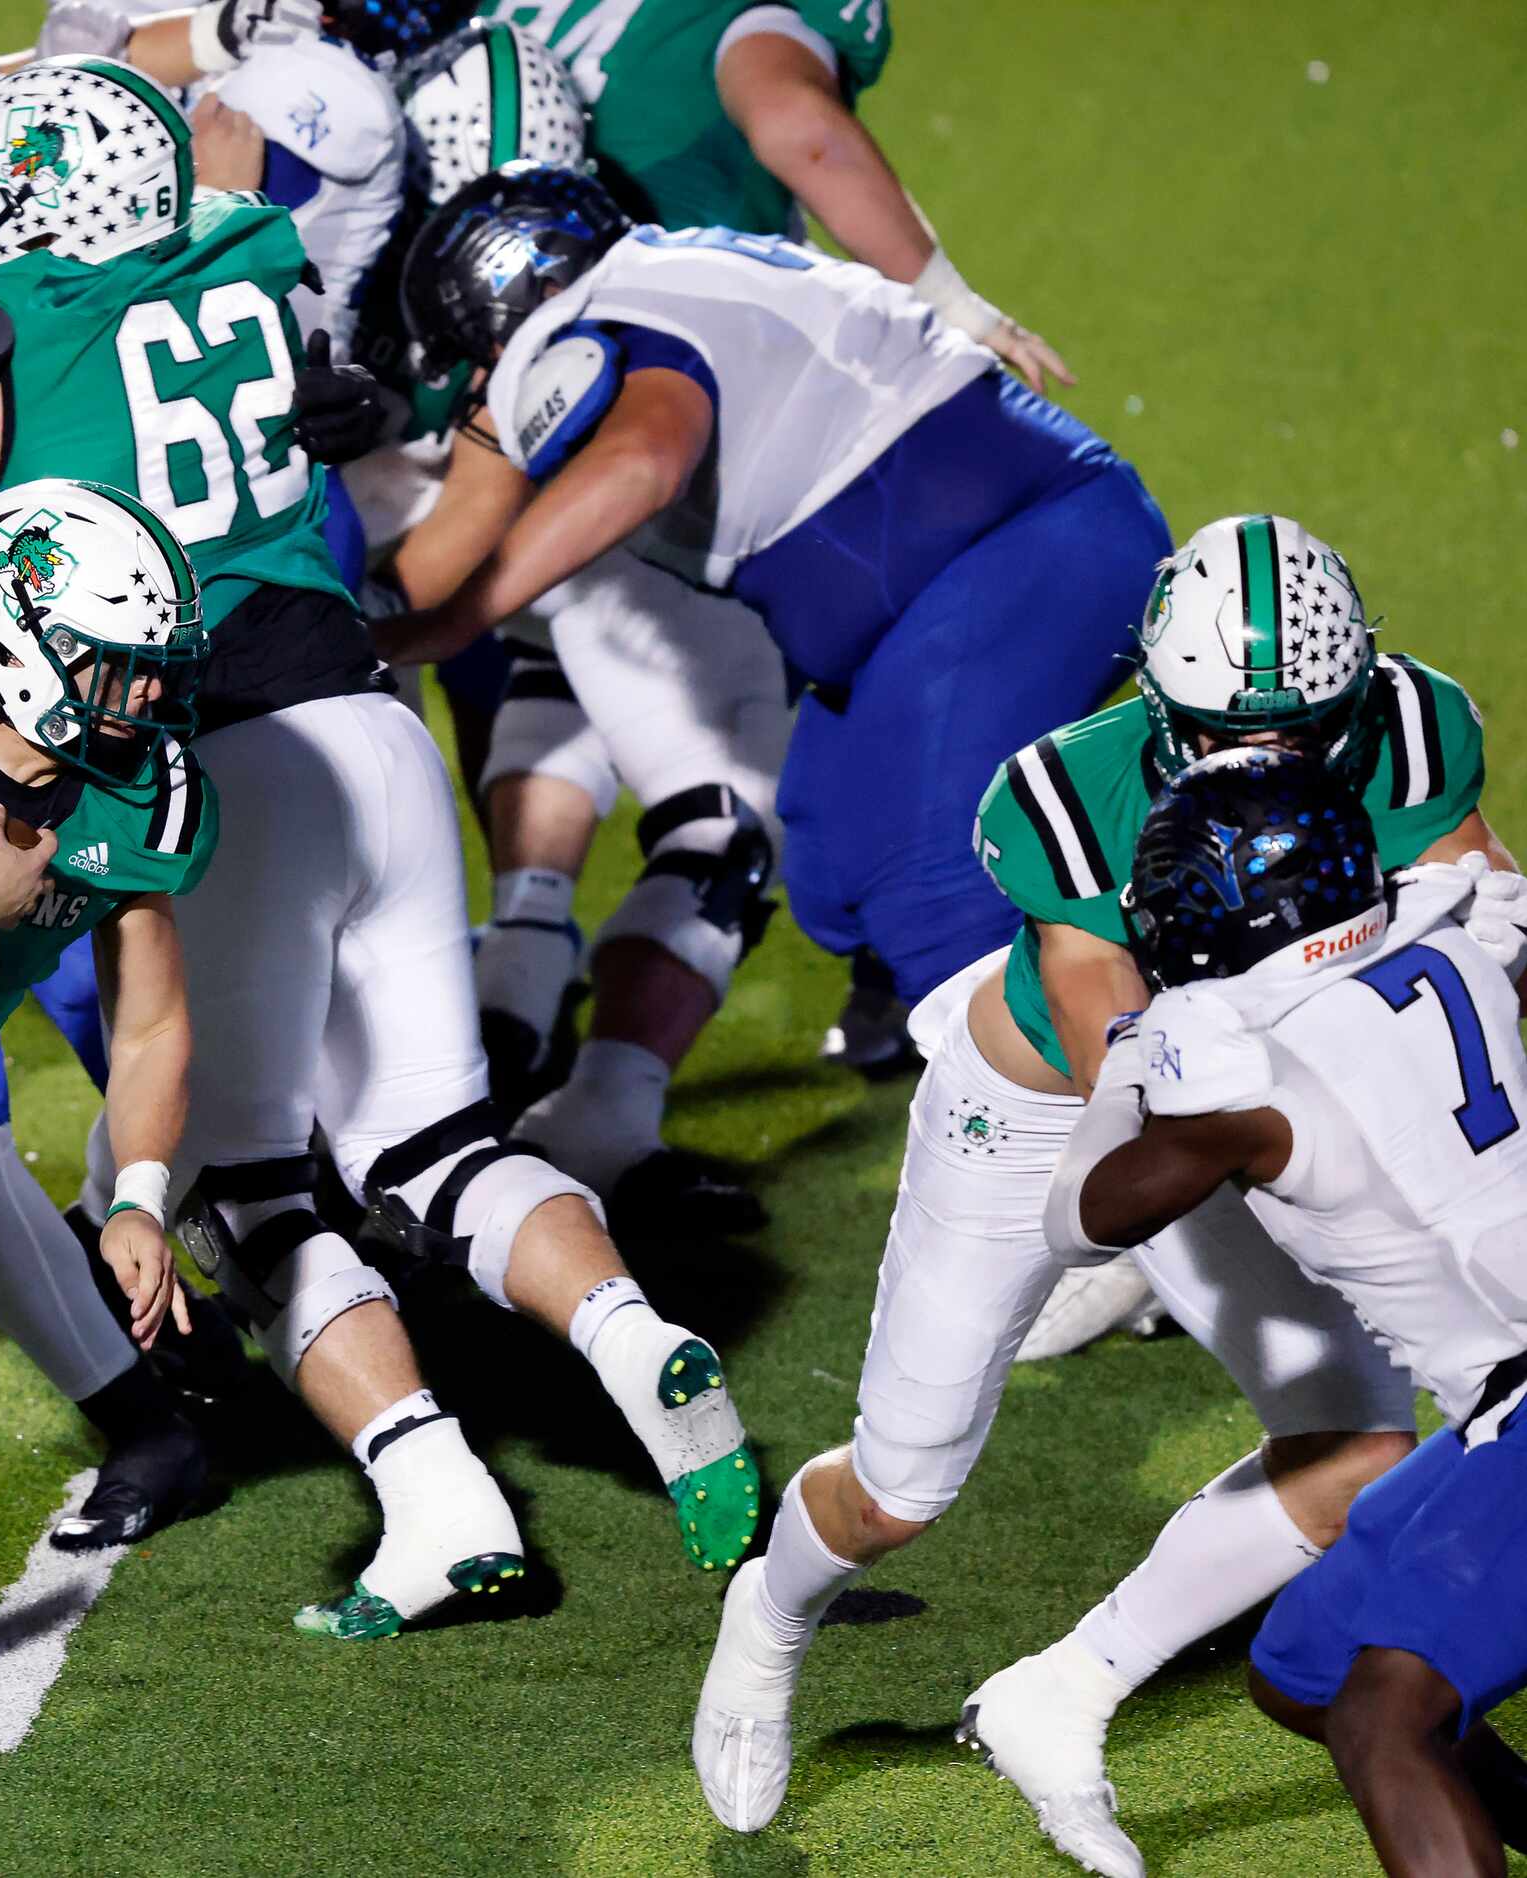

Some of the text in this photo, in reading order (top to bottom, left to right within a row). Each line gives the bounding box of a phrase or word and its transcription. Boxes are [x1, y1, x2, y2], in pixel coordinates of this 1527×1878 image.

[115, 279, 310, 546] 62
[68, 854, 110, 876] adidas
[1350, 943, 1520, 1156] 7
